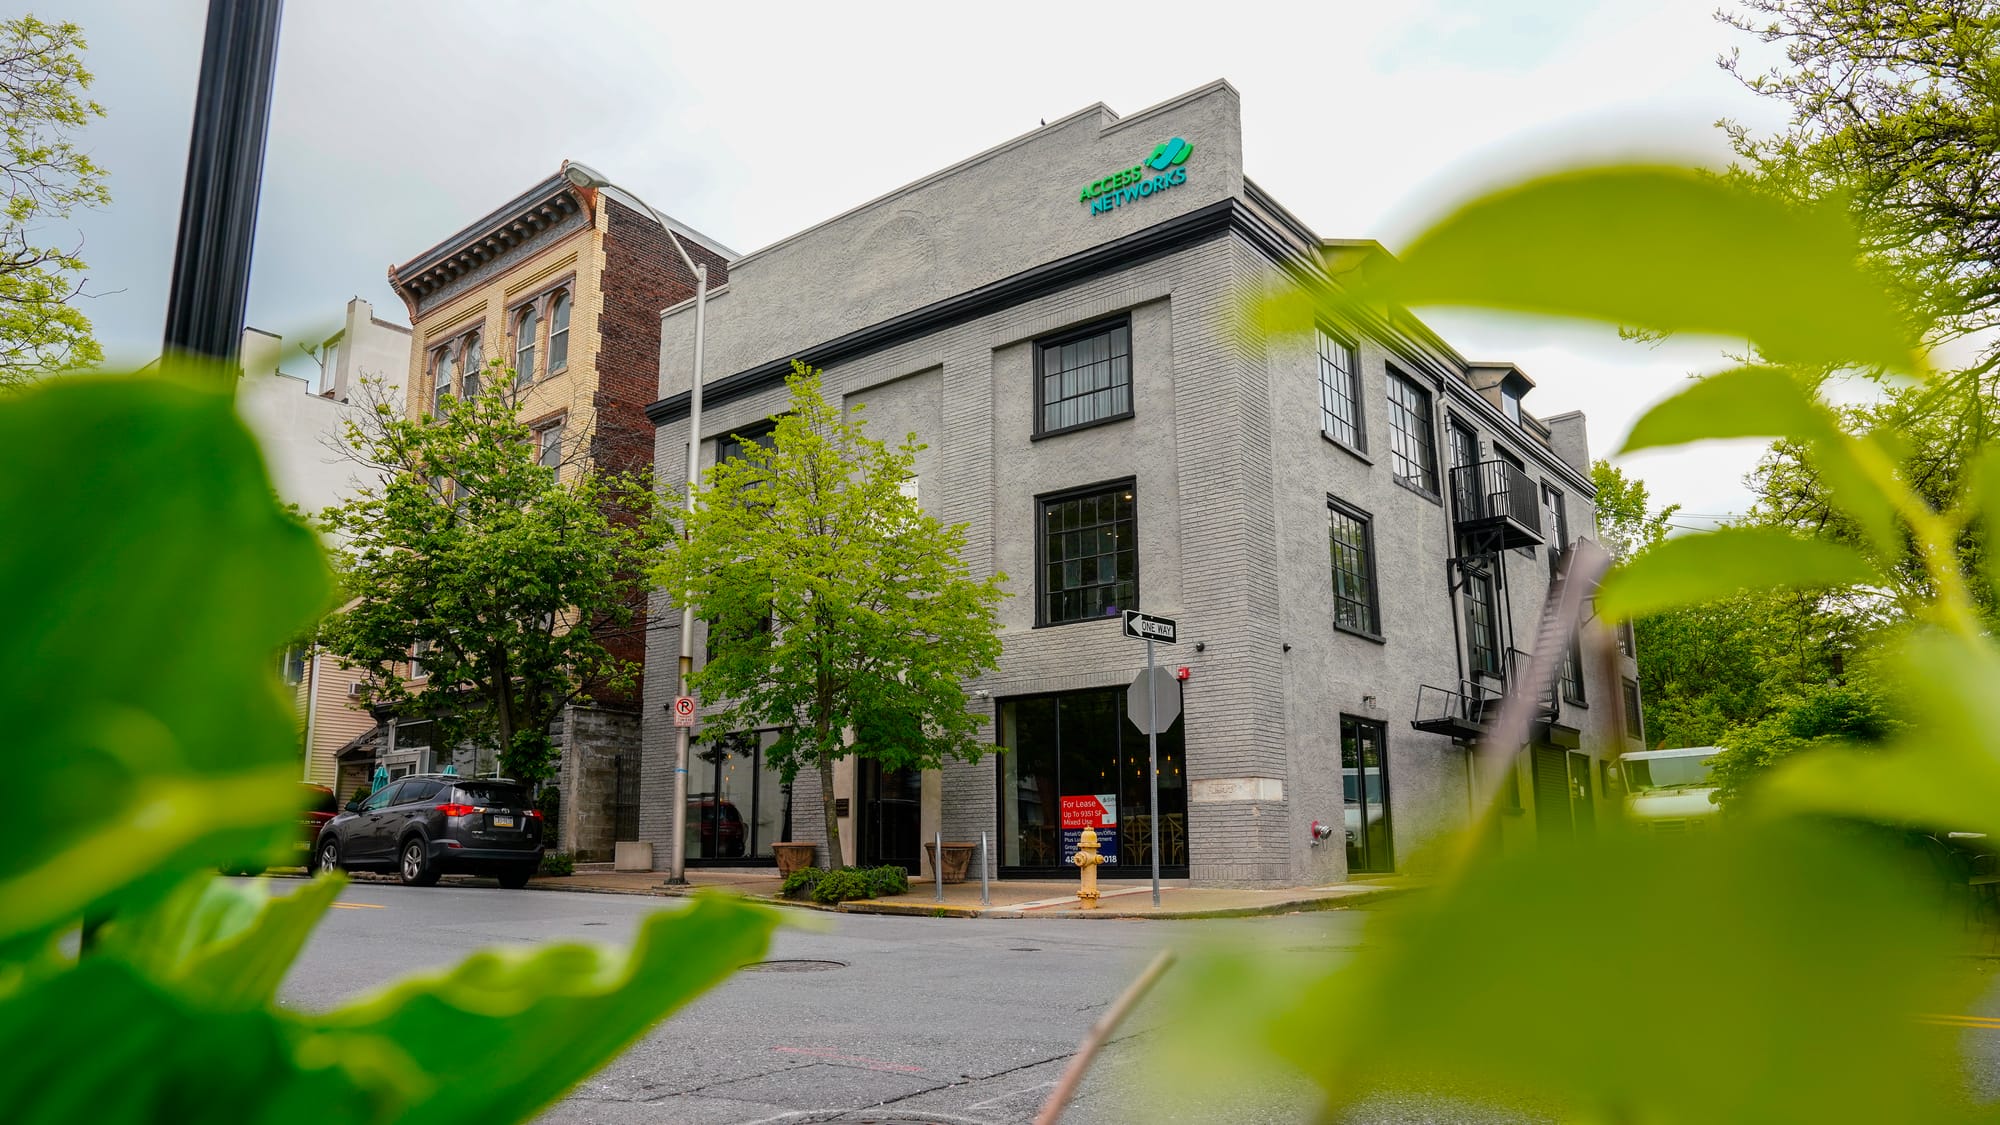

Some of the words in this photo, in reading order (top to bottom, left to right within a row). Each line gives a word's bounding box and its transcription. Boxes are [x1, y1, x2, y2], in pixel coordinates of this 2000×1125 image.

[1080, 165, 1142, 202] ACCESS
[1091, 166, 1187, 216] NETWORKS
[1142, 621, 1155, 632] ONE
[1158, 624, 1171, 635] WAY
[1063, 800, 1074, 808] For
[1075, 800, 1096, 808] Lease
